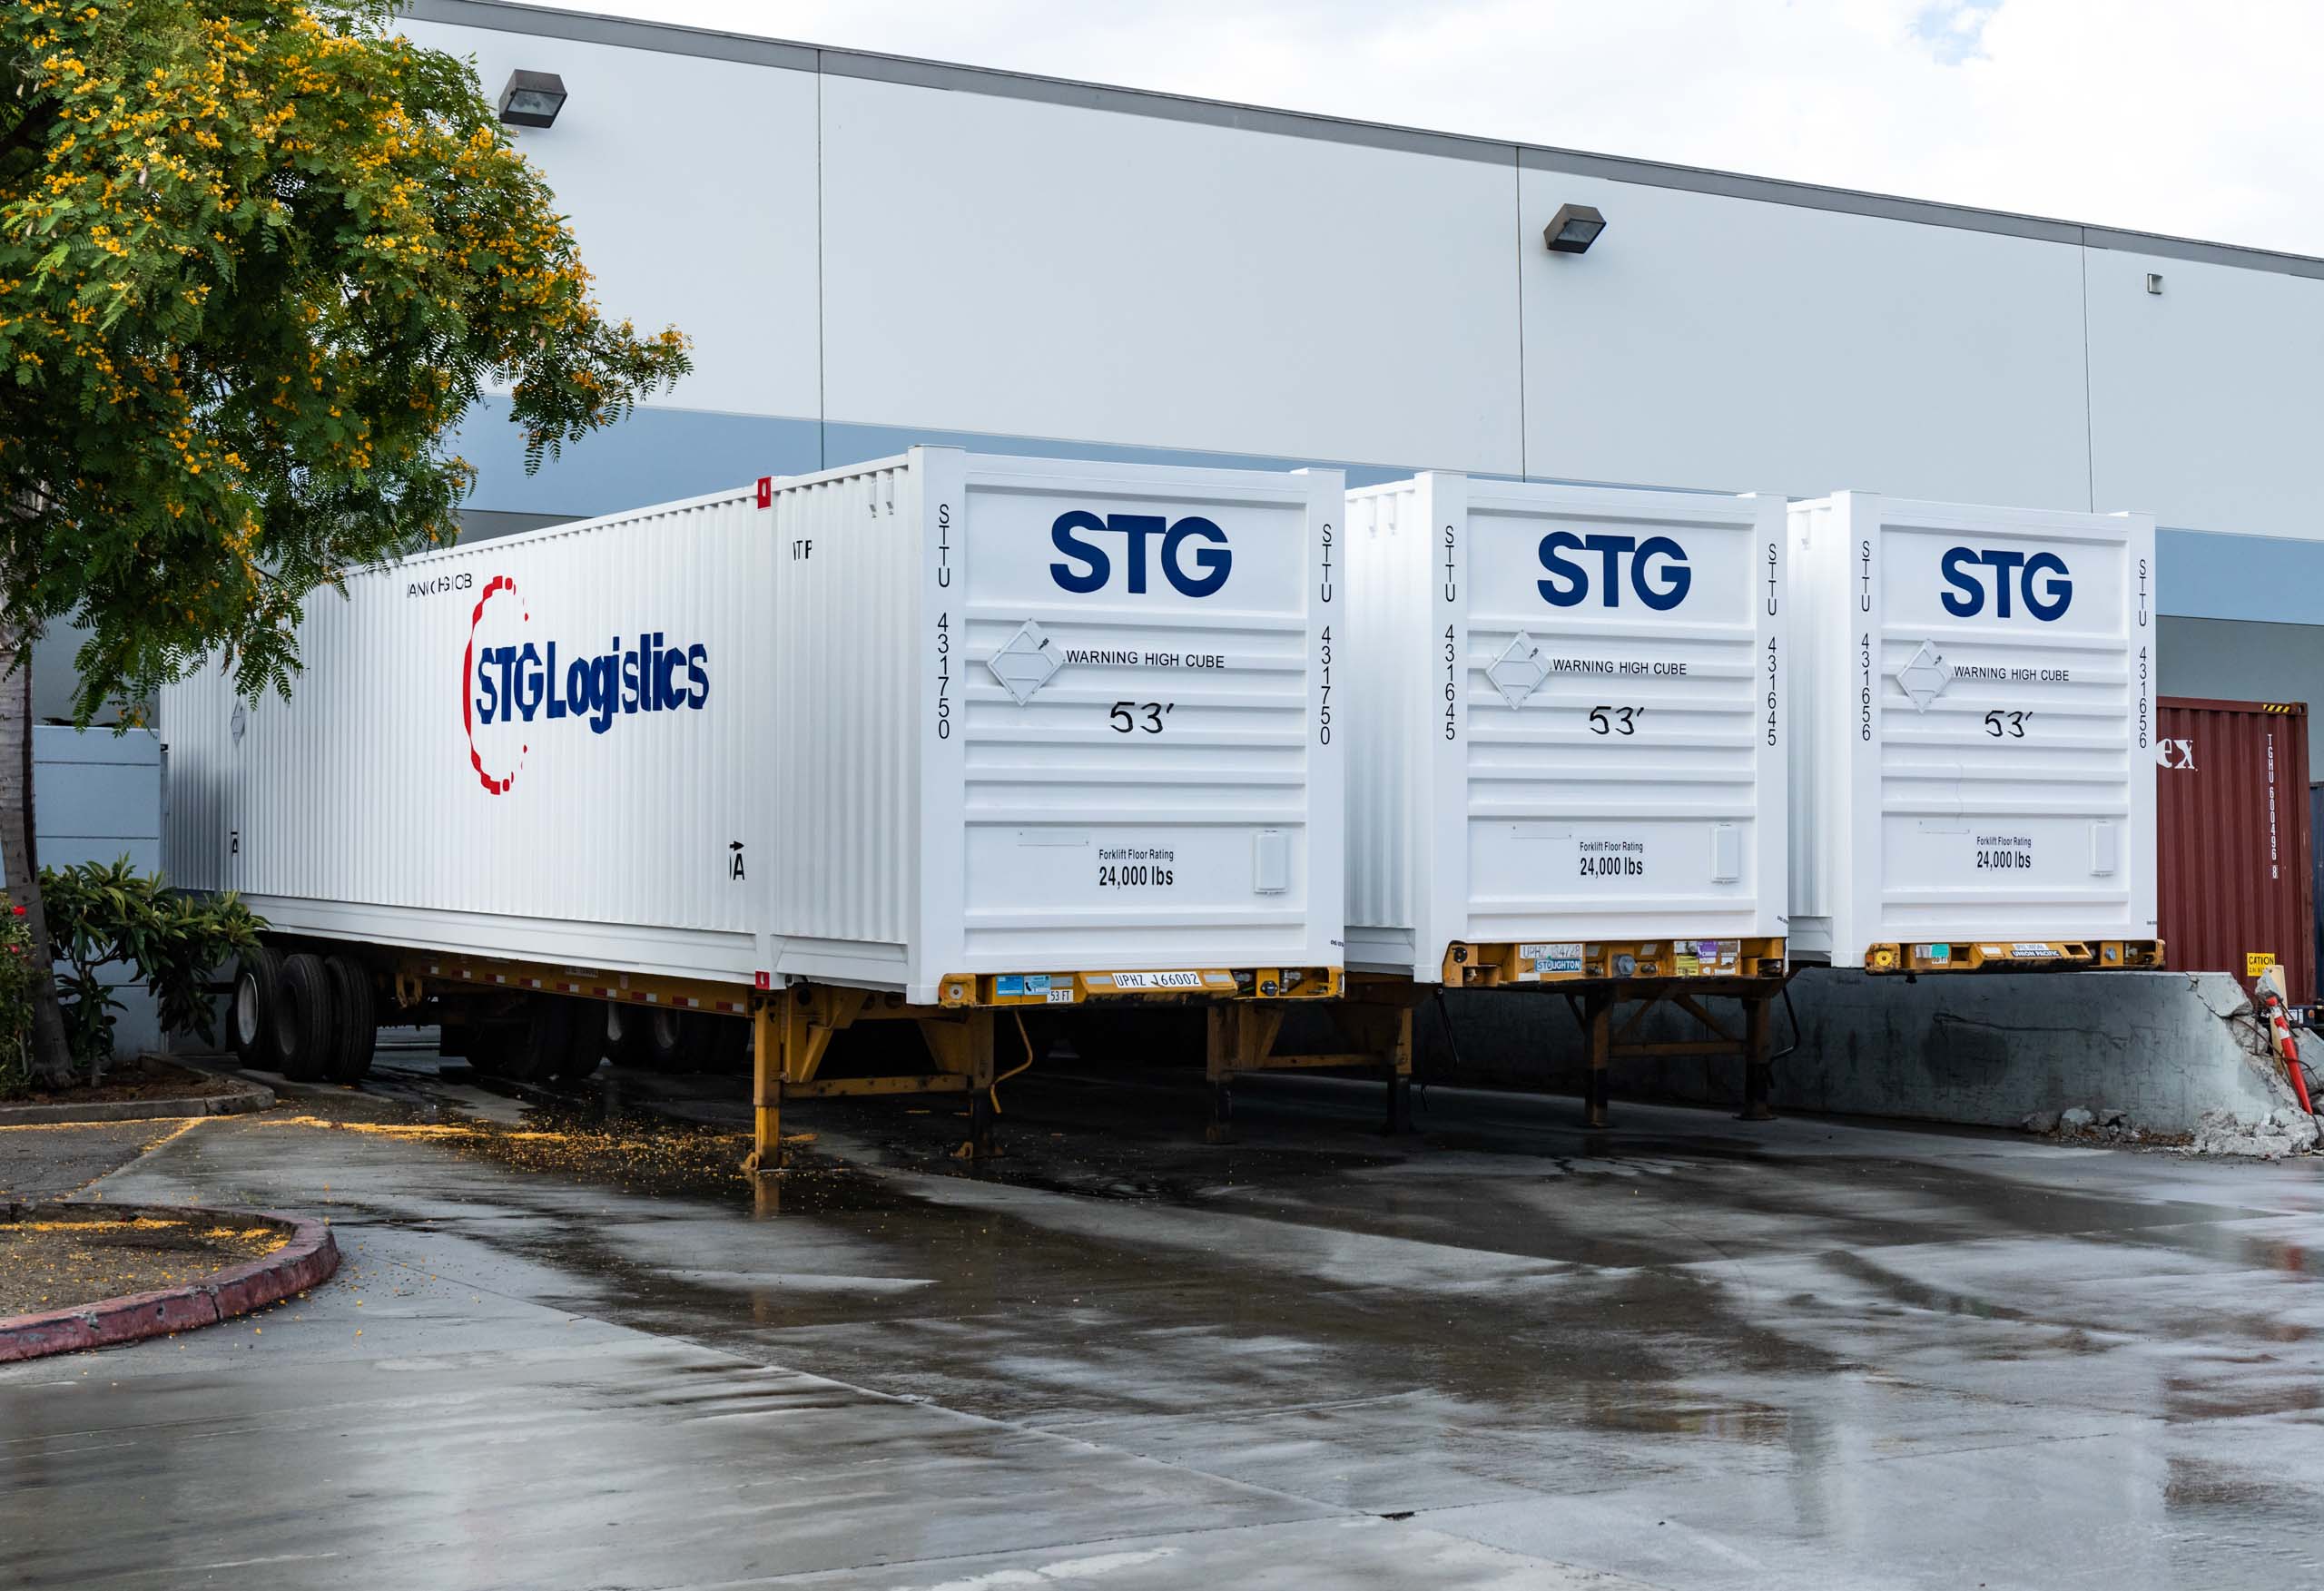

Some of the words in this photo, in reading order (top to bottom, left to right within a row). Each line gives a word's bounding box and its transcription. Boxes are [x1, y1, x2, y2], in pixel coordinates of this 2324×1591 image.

[938, 504, 950, 588] STTU
[1049, 510, 1233, 598] STG
[1321, 523, 1332, 603] STTU
[1444, 525, 1455, 603] STTU
[1537, 531, 1692, 612] STG
[1768, 543, 1777, 616] STTU
[1861, 540, 1871, 613] STTU
[1940, 546, 2073, 622] STG
[2139, 558, 2147, 627] STTU
[476, 643, 544, 724] STG
[937, 612, 950, 740] 431750
[1066, 650, 1138, 664] WARNING
[1145, 653, 1179, 666] HIGH
[1186, 654, 1225, 668] CUBE
[1320, 625, 1332, 745] 431750
[1444, 624, 1455, 741] 431645
[1553, 659, 1614, 673] WARNING
[1620, 662, 1649, 674] HIGH
[1653, 663, 1687, 675] CUBE
[1768, 636, 1777, 746] 431645
[1861, 633, 1871, 741] 431656
[1954, 666, 2006, 680] WARNING
[2011, 668, 2037, 681] HIGH
[2041, 669, 2070, 682] CUBE
[1109, 701, 1175, 734] 53'
[1589, 705, 1645, 736] 53'
[1984, 710, 2034, 738] 53'
[2139, 645, 2147, 749] 431656
[1098, 849, 1126, 859] Forklift
[1128, 849, 1147, 859] Floor
[1149, 849, 1174, 861] Rating
[1580, 841, 1603, 851] Forklift
[1604, 841, 1621, 851] Floor
[1622, 841, 1643, 853] Rating
[1580, 857, 1621, 879] 24,000
[1624, 856, 1643, 876] lbs
[1976, 836, 1997, 846] Forklift
[1997, 836, 2013, 846] Floor
[2013, 836, 2032, 848] Rating
[1976, 850, 2013, 871] 24,000
[2014, 850, 2031, 869] lbs
[1098, 865, 1147, 889] 24,000
[1151, 865, 1174, 886] lbs
[1050, 990, 1059, 1003] 53
[1061, 989, 1071, 1002] FT
[1115, 974, 1147, 987] UPHZ
[1536, 959, 1581, 971] STOUGHTON
